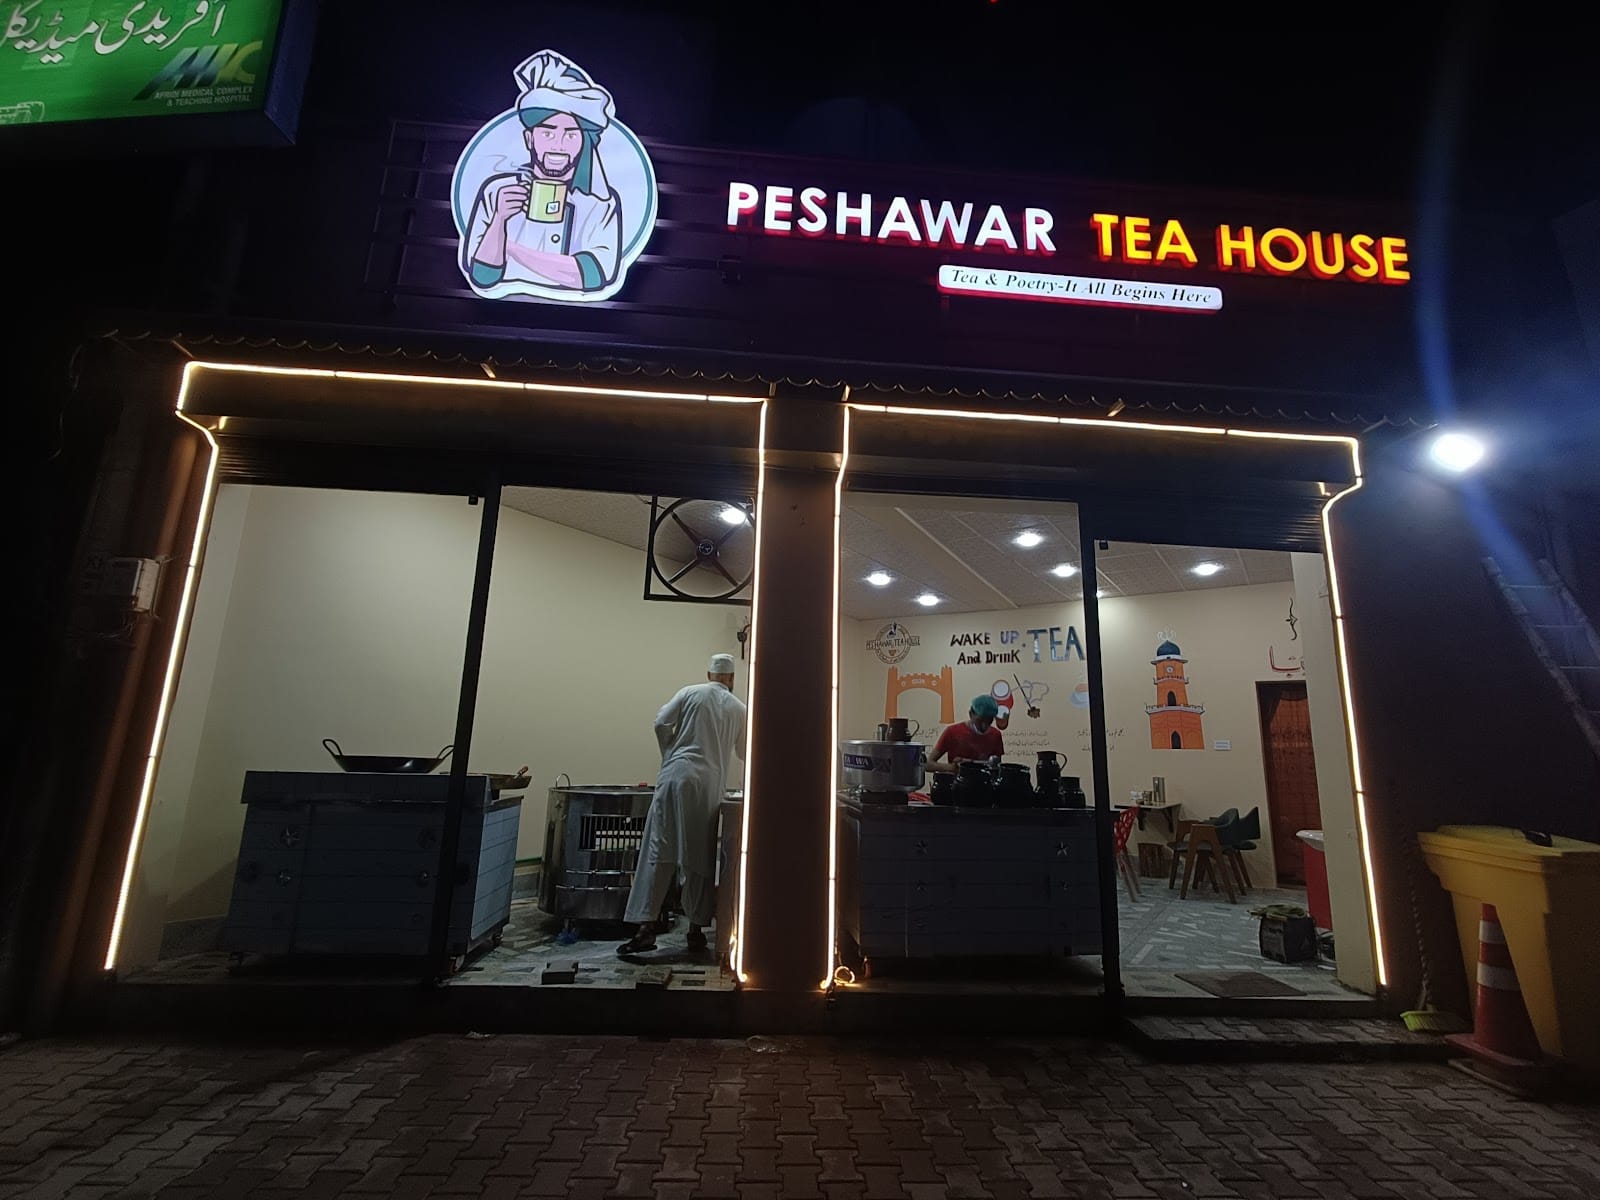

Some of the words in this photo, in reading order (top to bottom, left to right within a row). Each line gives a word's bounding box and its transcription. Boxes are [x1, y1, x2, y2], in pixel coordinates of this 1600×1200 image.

[154, 90, 180, 99] AFRIDI
[181, 87, 213, 97] MEDICAL
[216, 86, 253, 95] COMPLEX
[176, 97, 212, 106] TEACHING
[214, 95, 250, 104] HOSPITAL
[727, 182, 1057, 252] PESHAWAR
[1092, 212, 1198, 264] TEA
[1217, 224, 1411, 283] HOUSE
[952, 269, 978, 284] Tea
[985, 273, 998, 286] &
[1006, 274, 1077, 294] Poetry-It
[1081, 282, 1106, 295] All
[1112, 283, 1166, 301] Begins
[1172, 288, 1212, 303] Here
[950, 632, 991, 647] WAKE
[1026, 625, 1086, 663] TEA
[957, 650, 981, 665] And
